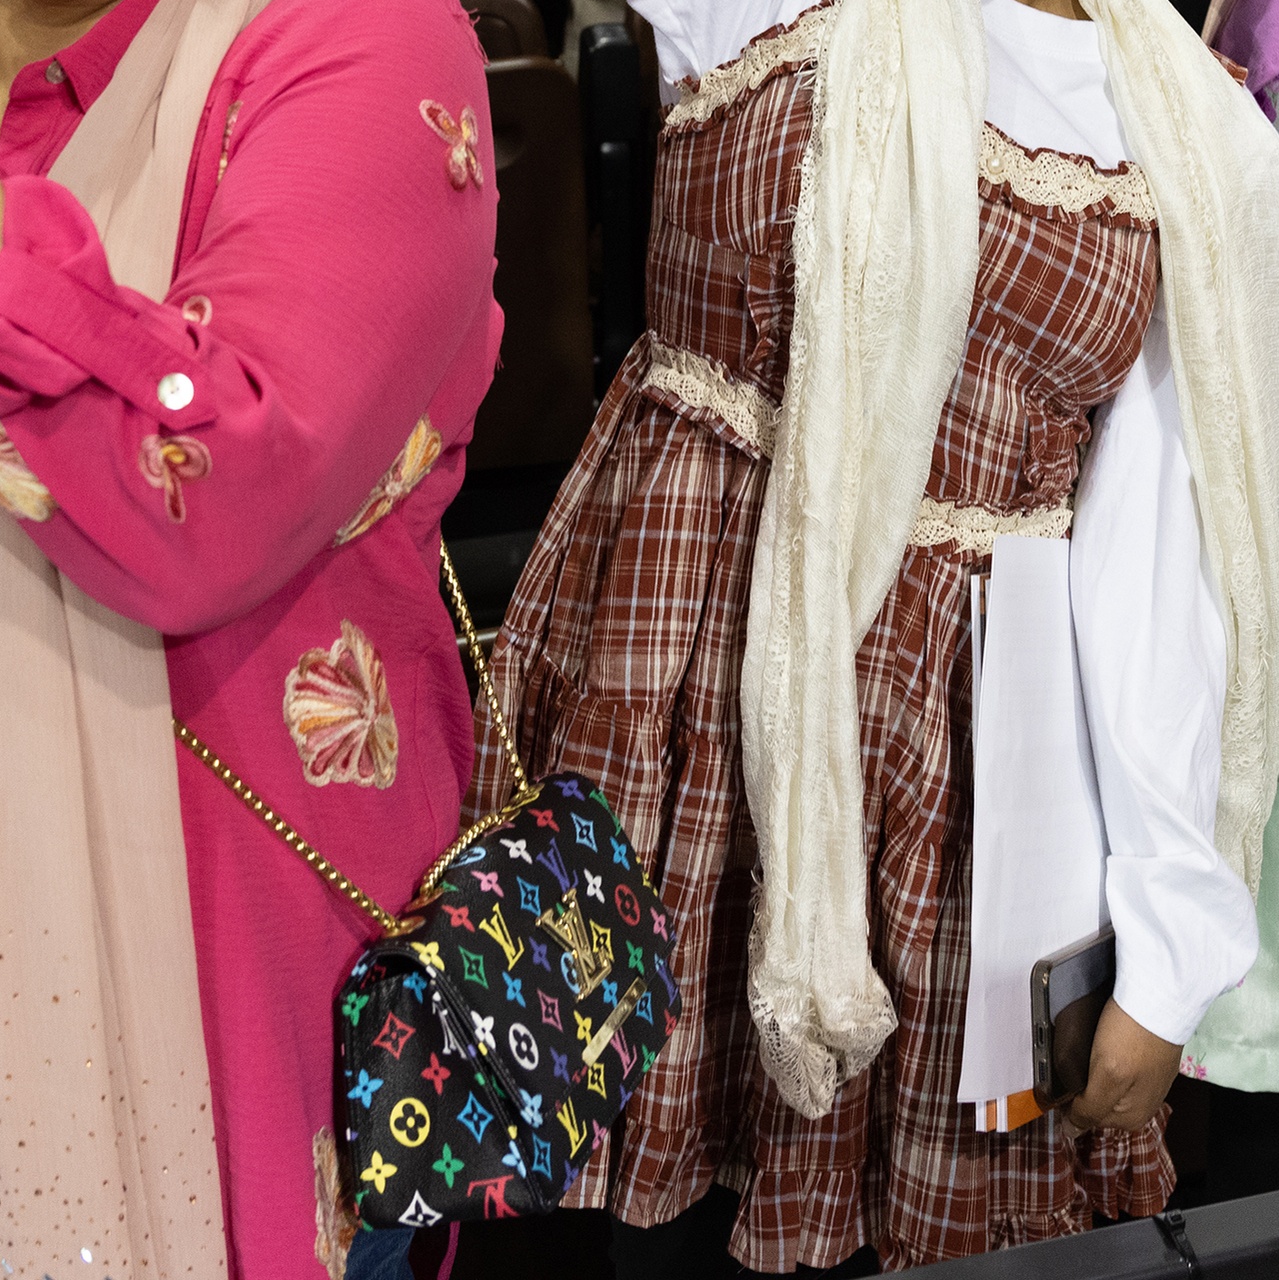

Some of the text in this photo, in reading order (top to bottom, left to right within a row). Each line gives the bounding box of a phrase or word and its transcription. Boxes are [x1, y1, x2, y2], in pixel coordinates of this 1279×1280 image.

[478, 902, 526, 971] LV
[535, 886, 612, 1003] LV
[556, 1096, 588, 1161] LV
